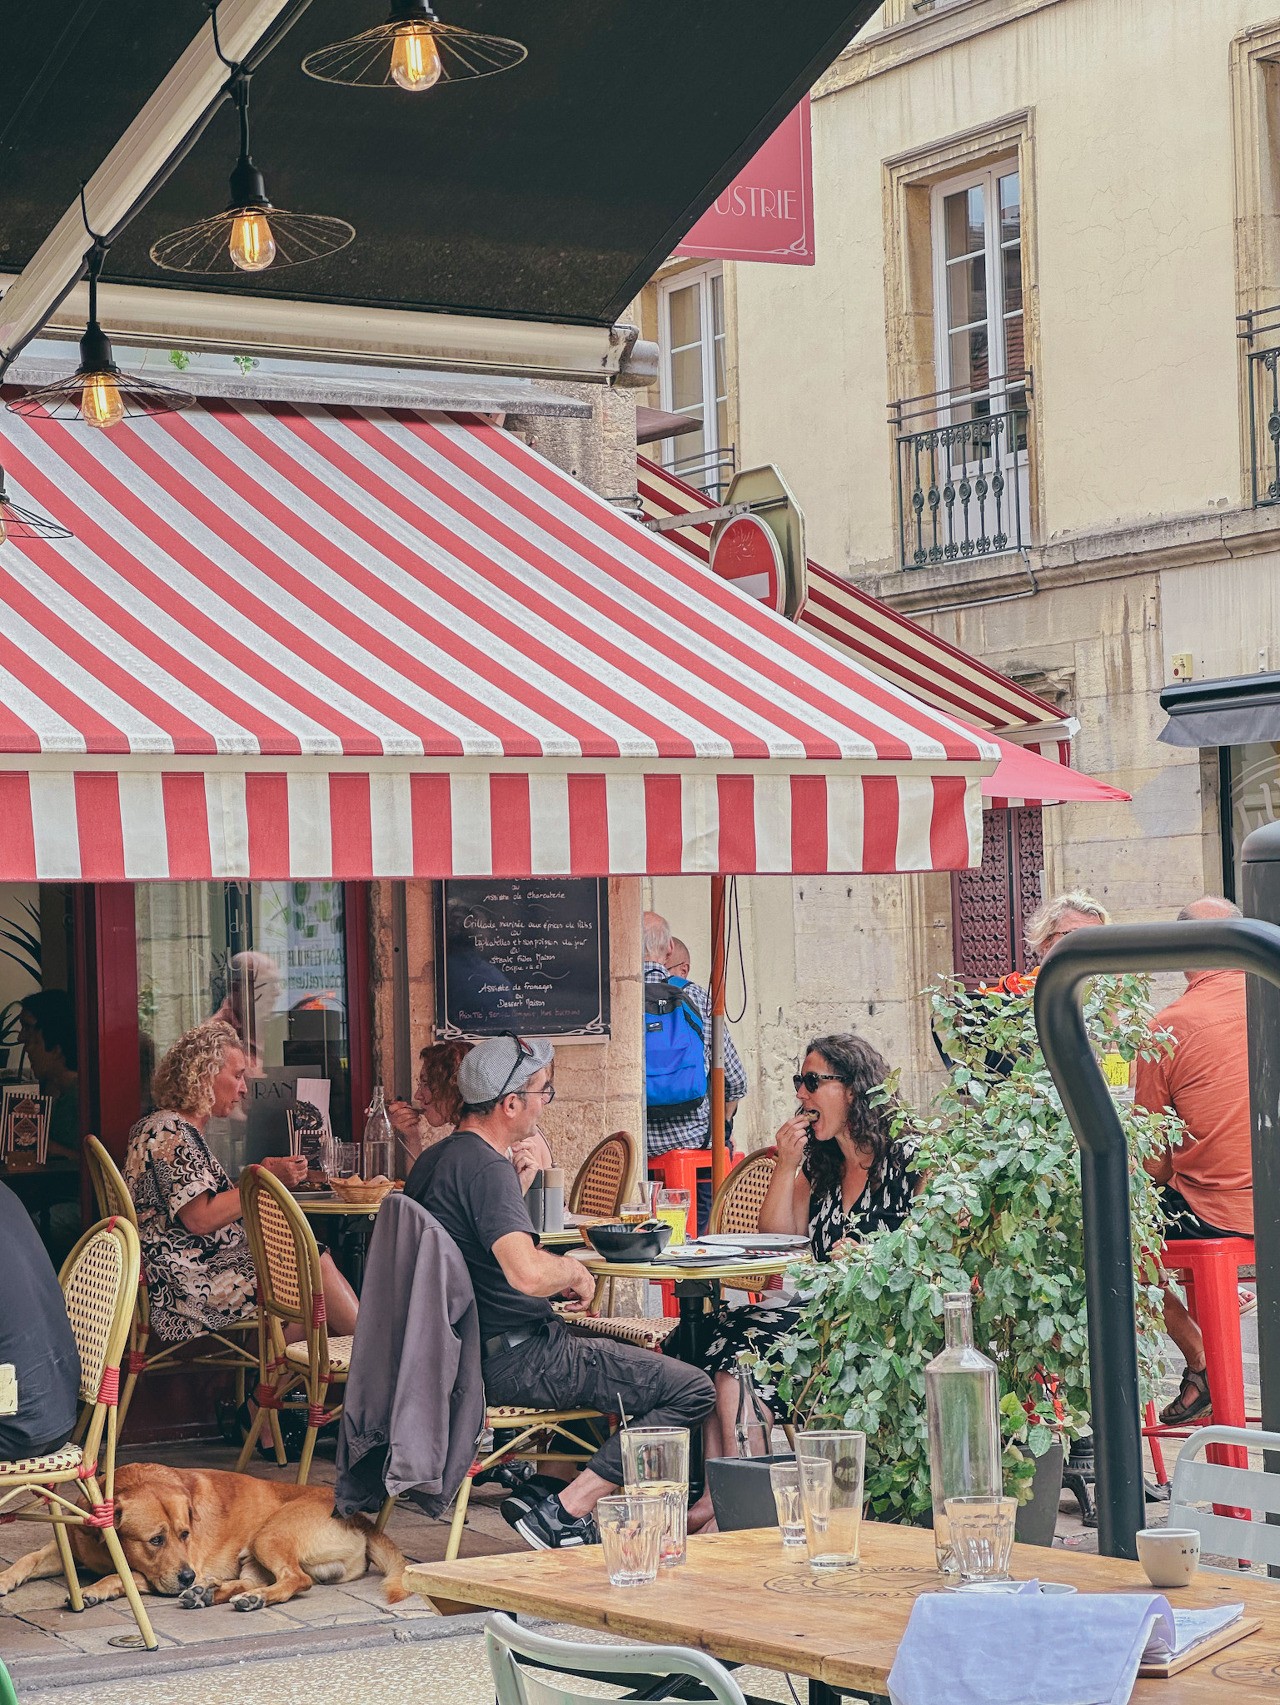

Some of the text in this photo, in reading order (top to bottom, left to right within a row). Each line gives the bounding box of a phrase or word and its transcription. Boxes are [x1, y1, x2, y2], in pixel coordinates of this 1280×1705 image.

[714, 186, 797, 220] USTRIE
[497, 998, 545, 1009] Dessert Maison
